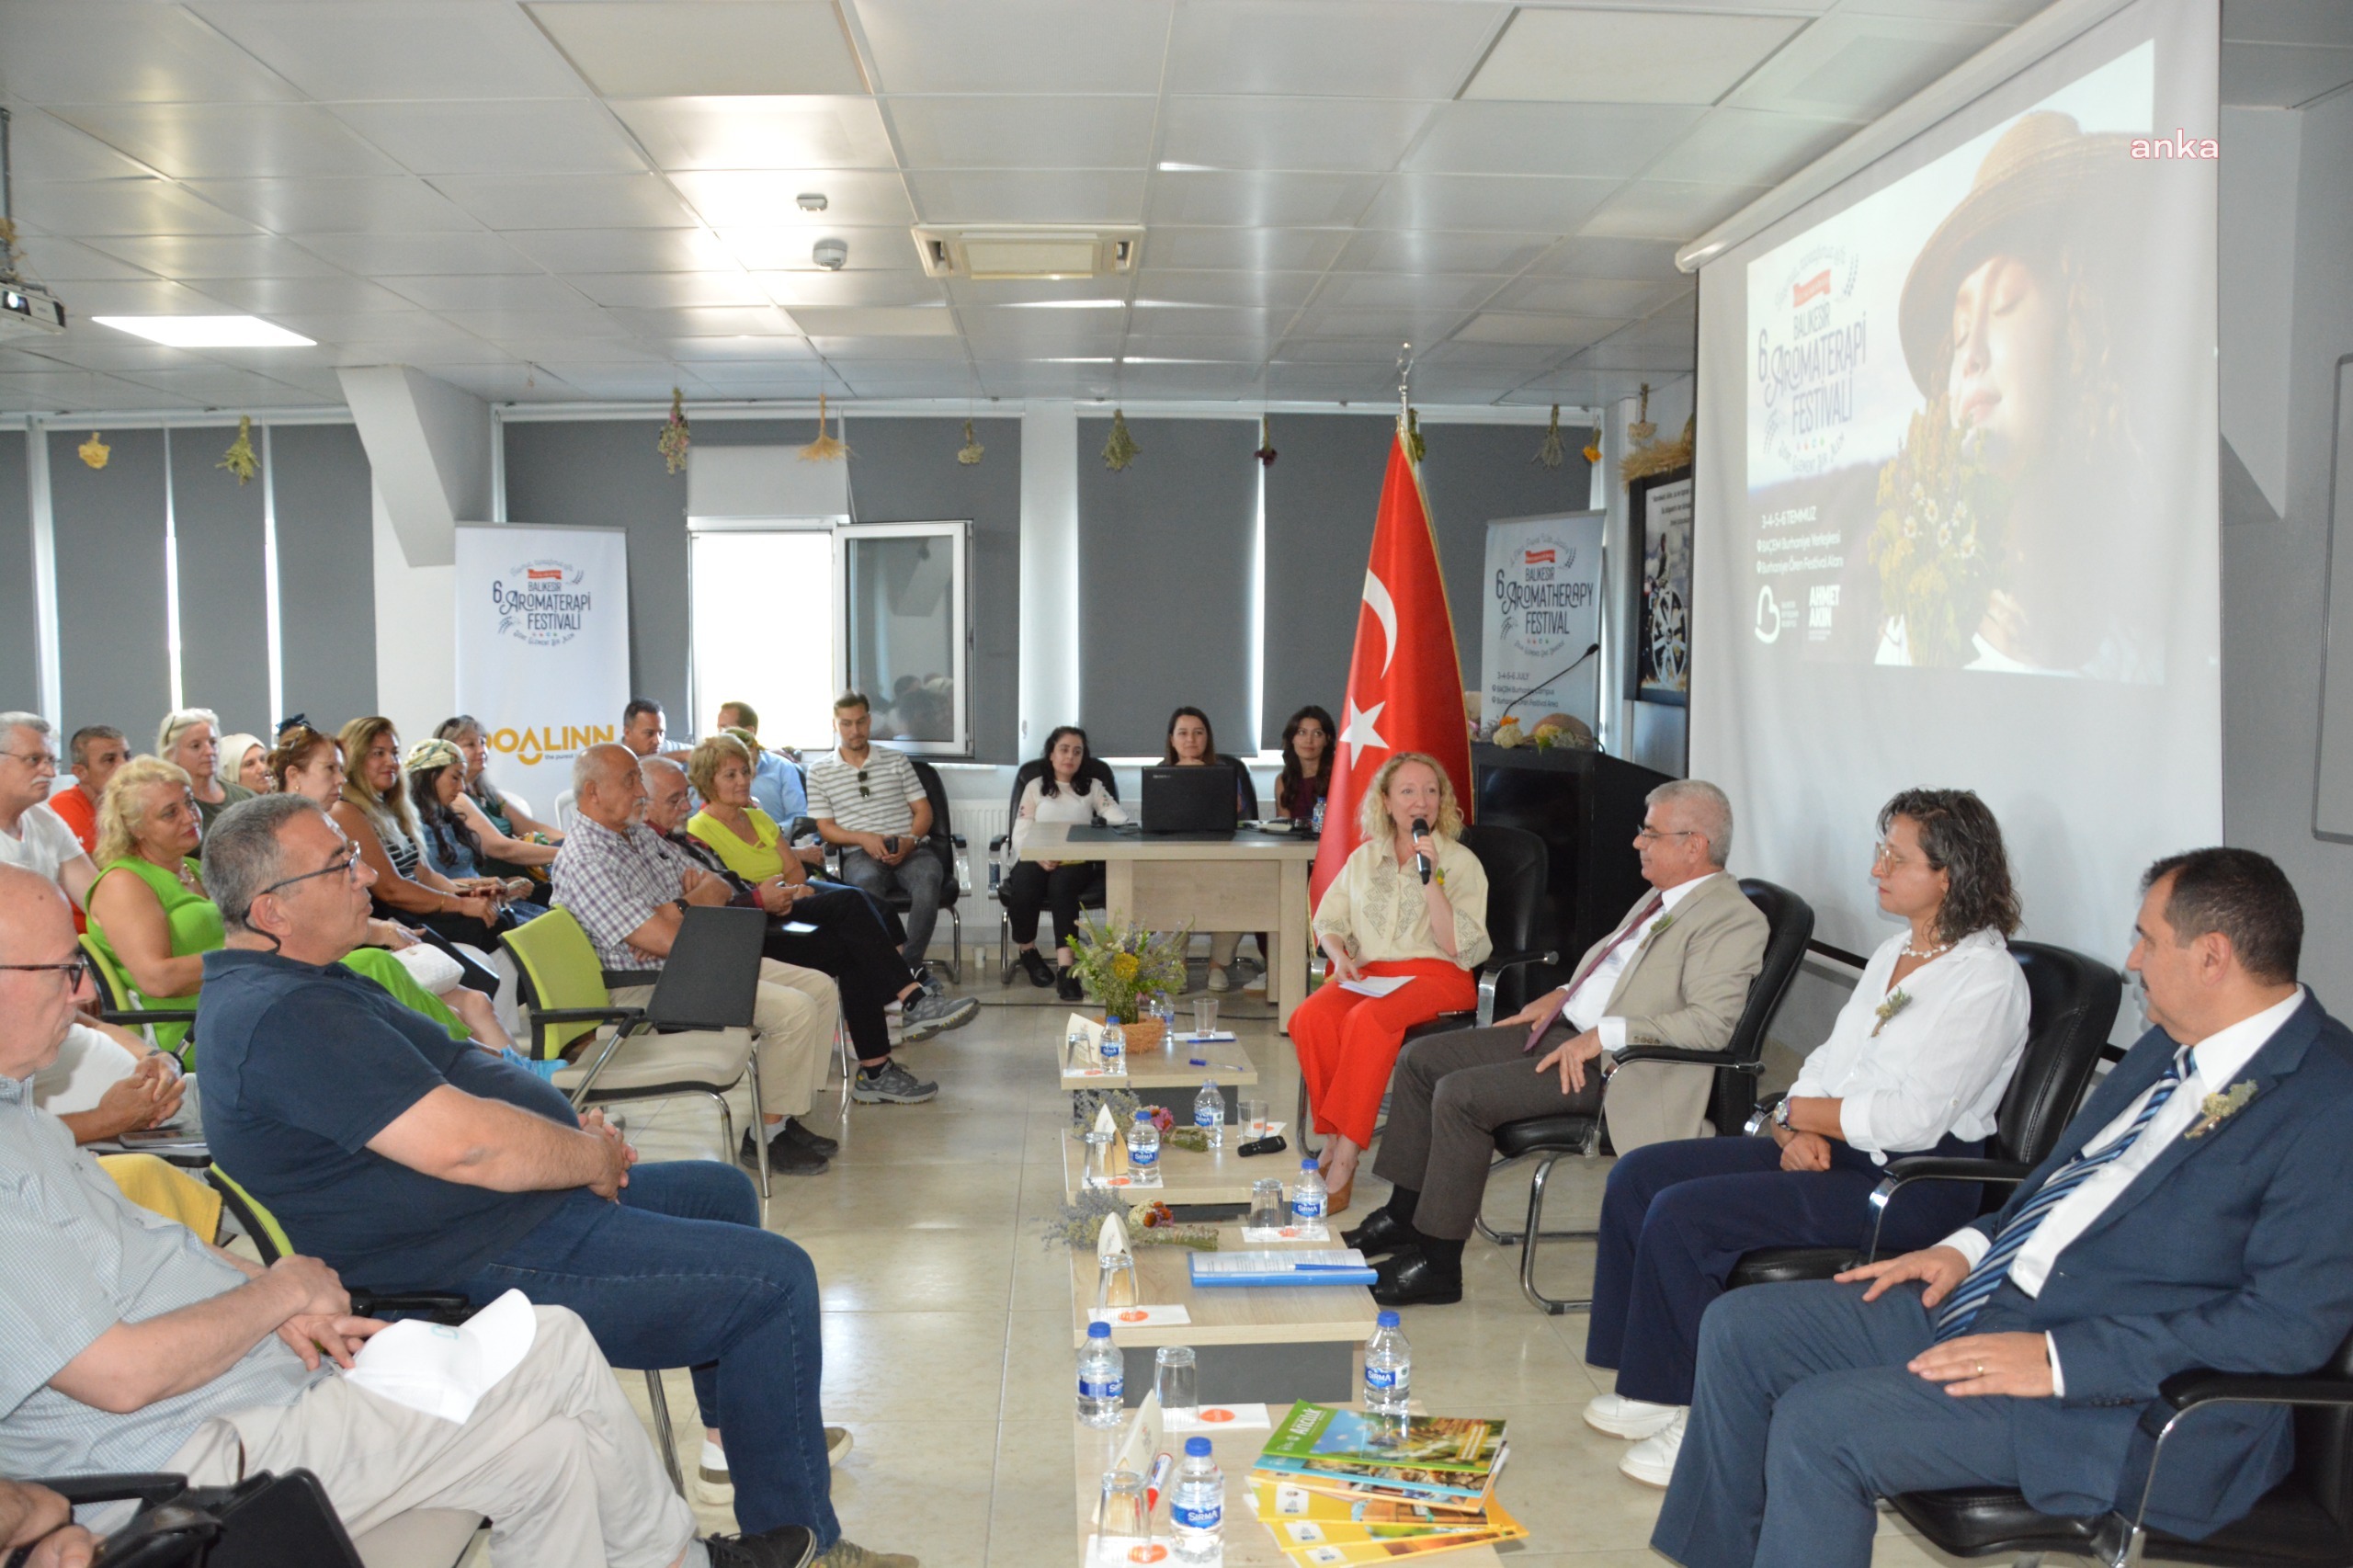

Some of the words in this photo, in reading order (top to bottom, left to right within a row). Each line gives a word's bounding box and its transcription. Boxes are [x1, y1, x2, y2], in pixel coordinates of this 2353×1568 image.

[1764, 311, 1867, 408] AROMATERAPİ
[1792, 370, 1853, 436] FESTİVALİ
[499, 590, 591, 615] AROMATERAPİ
[1501, 581, 1594, 615] AROMATHERAPY
[1808, 584, 1841, 607] AHMET
[528, 610, 581, 630] FESTİVALİ
[1525, 610, 1570, 635] FESTIVAL
[1808, 607, 1832, 628] AKIN
[555, 754, 574, 762] purest
